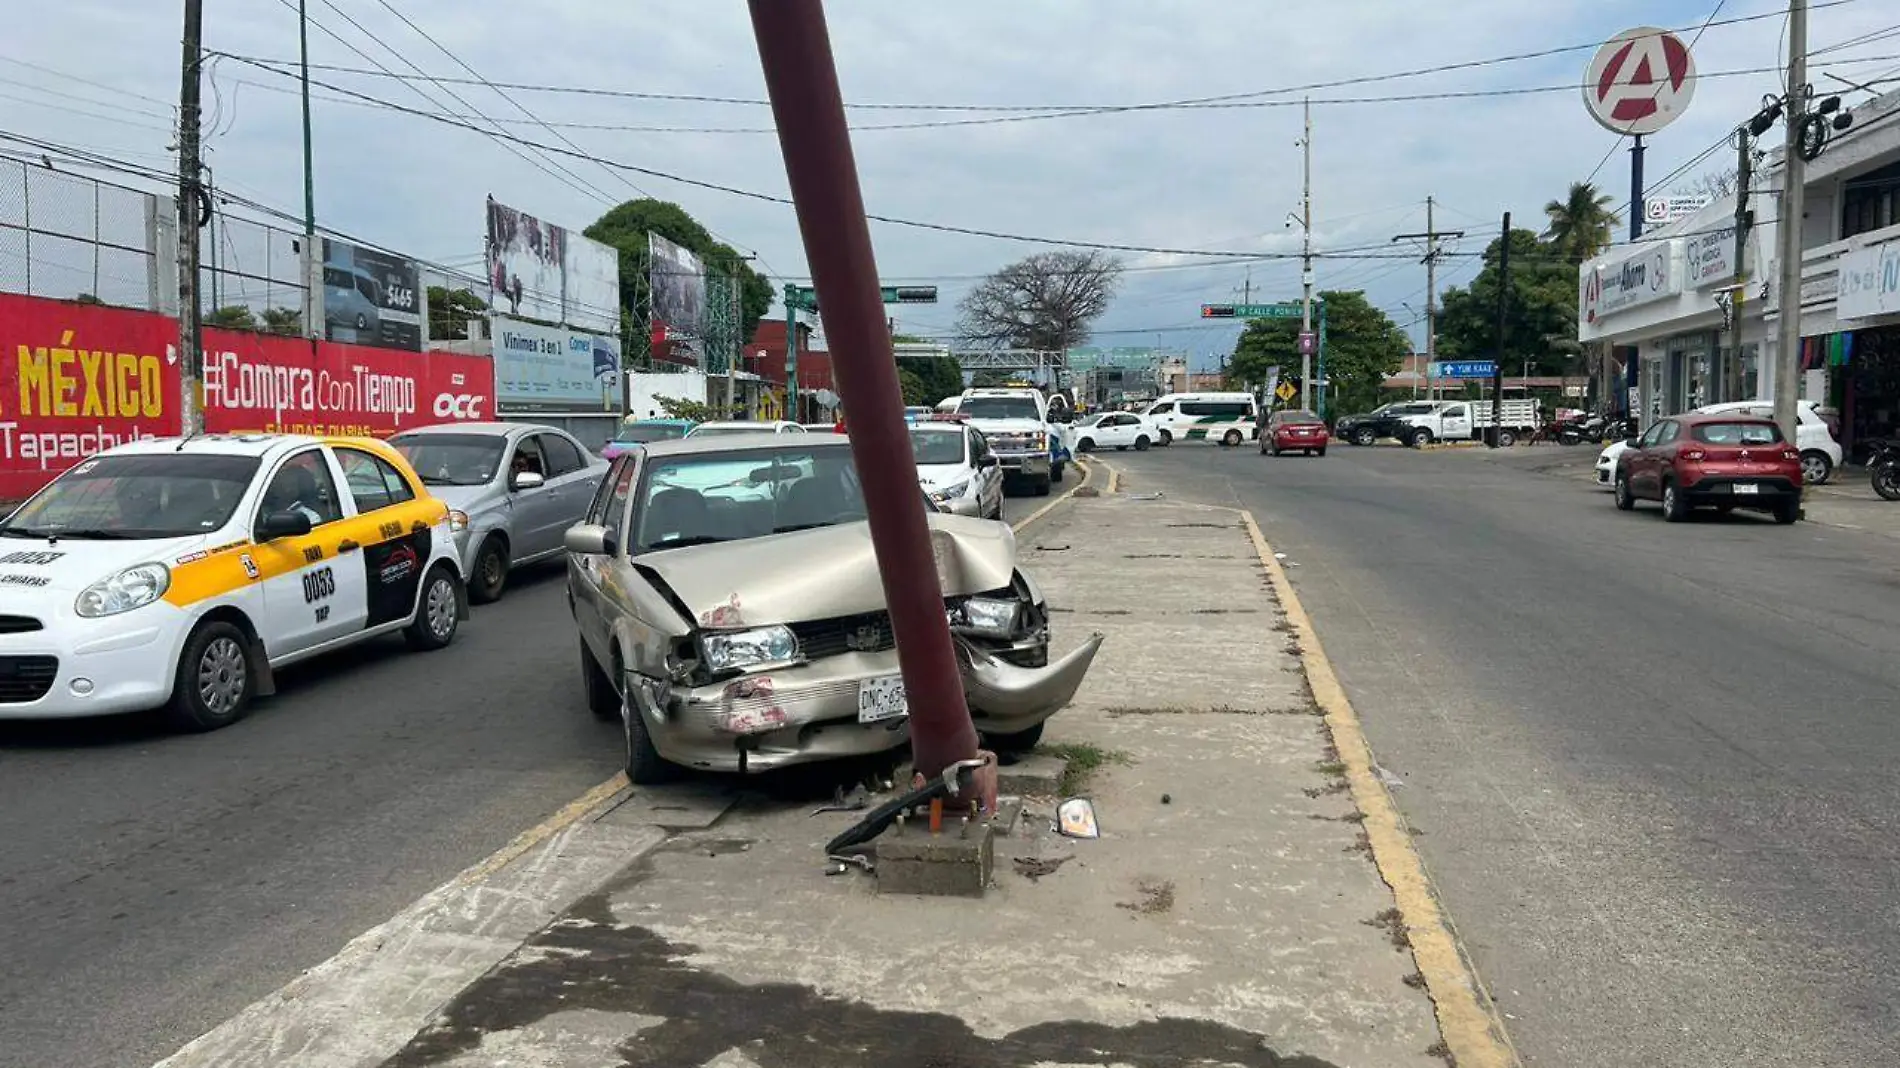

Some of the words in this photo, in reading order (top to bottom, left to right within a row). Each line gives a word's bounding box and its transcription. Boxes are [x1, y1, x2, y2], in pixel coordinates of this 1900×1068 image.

[1620, 261, 1646, 292] Ahorro
[1249, 306, 1271, 315] CALLE
[502, 331, 538, 353] Vinimex
[547, 341, 558, 355] en
[568, 335, 591, 352] Comex
[17, 330, 163, 418] MÉXICO
[265, 423, 324, 437] SALIDAS
[328, 424, 372, 437] DIARIAS
[0, 421, 158, 472] Tapachl
[303, 565, 335, 604] 0053
[315, 604, 330, 624] TAP
[862, 684, 905, 709] DNC-65
